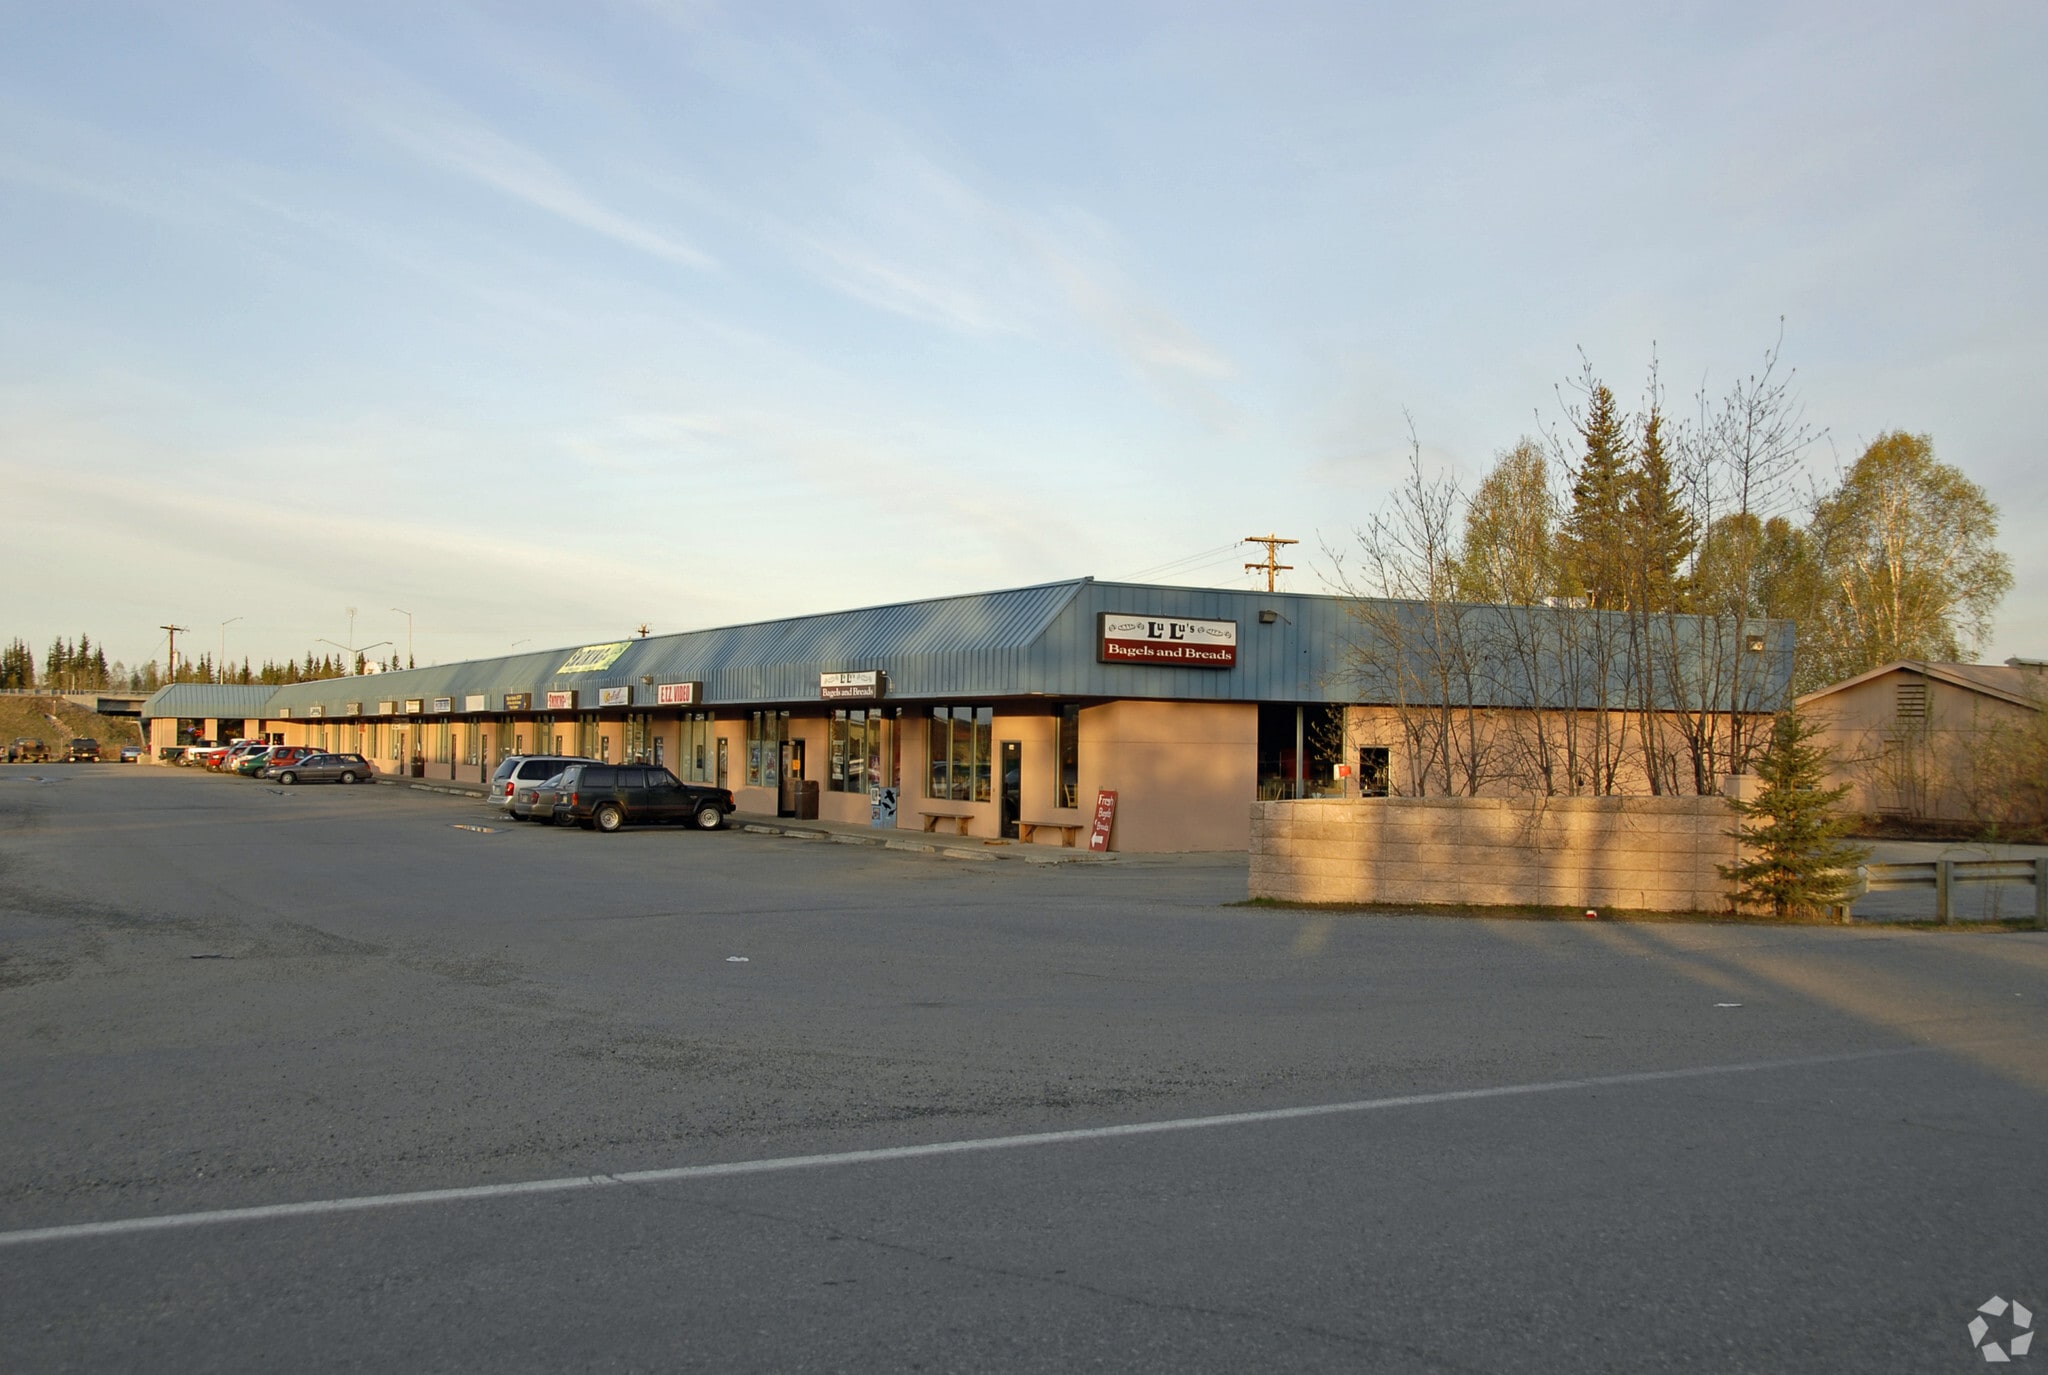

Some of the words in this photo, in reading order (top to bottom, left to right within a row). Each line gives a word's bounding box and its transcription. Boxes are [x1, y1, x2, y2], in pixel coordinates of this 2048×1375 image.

[1147, 621, 1164, 639] Lu
[1169, 622, 1195, 640] Lu's
[1108, 643, 1155, 657] Bagels
[1156, 647, 1182, 658] and
[1185, 647, 1232, 660] Breads
[673, 684, 690, 702] VIDEO
[822, 687, 841, 698] Bagels
[841, 687, 853, 697] and
[853, 686, 874, 697] Breads
[1098, 794, 1114, 806] Fresh
